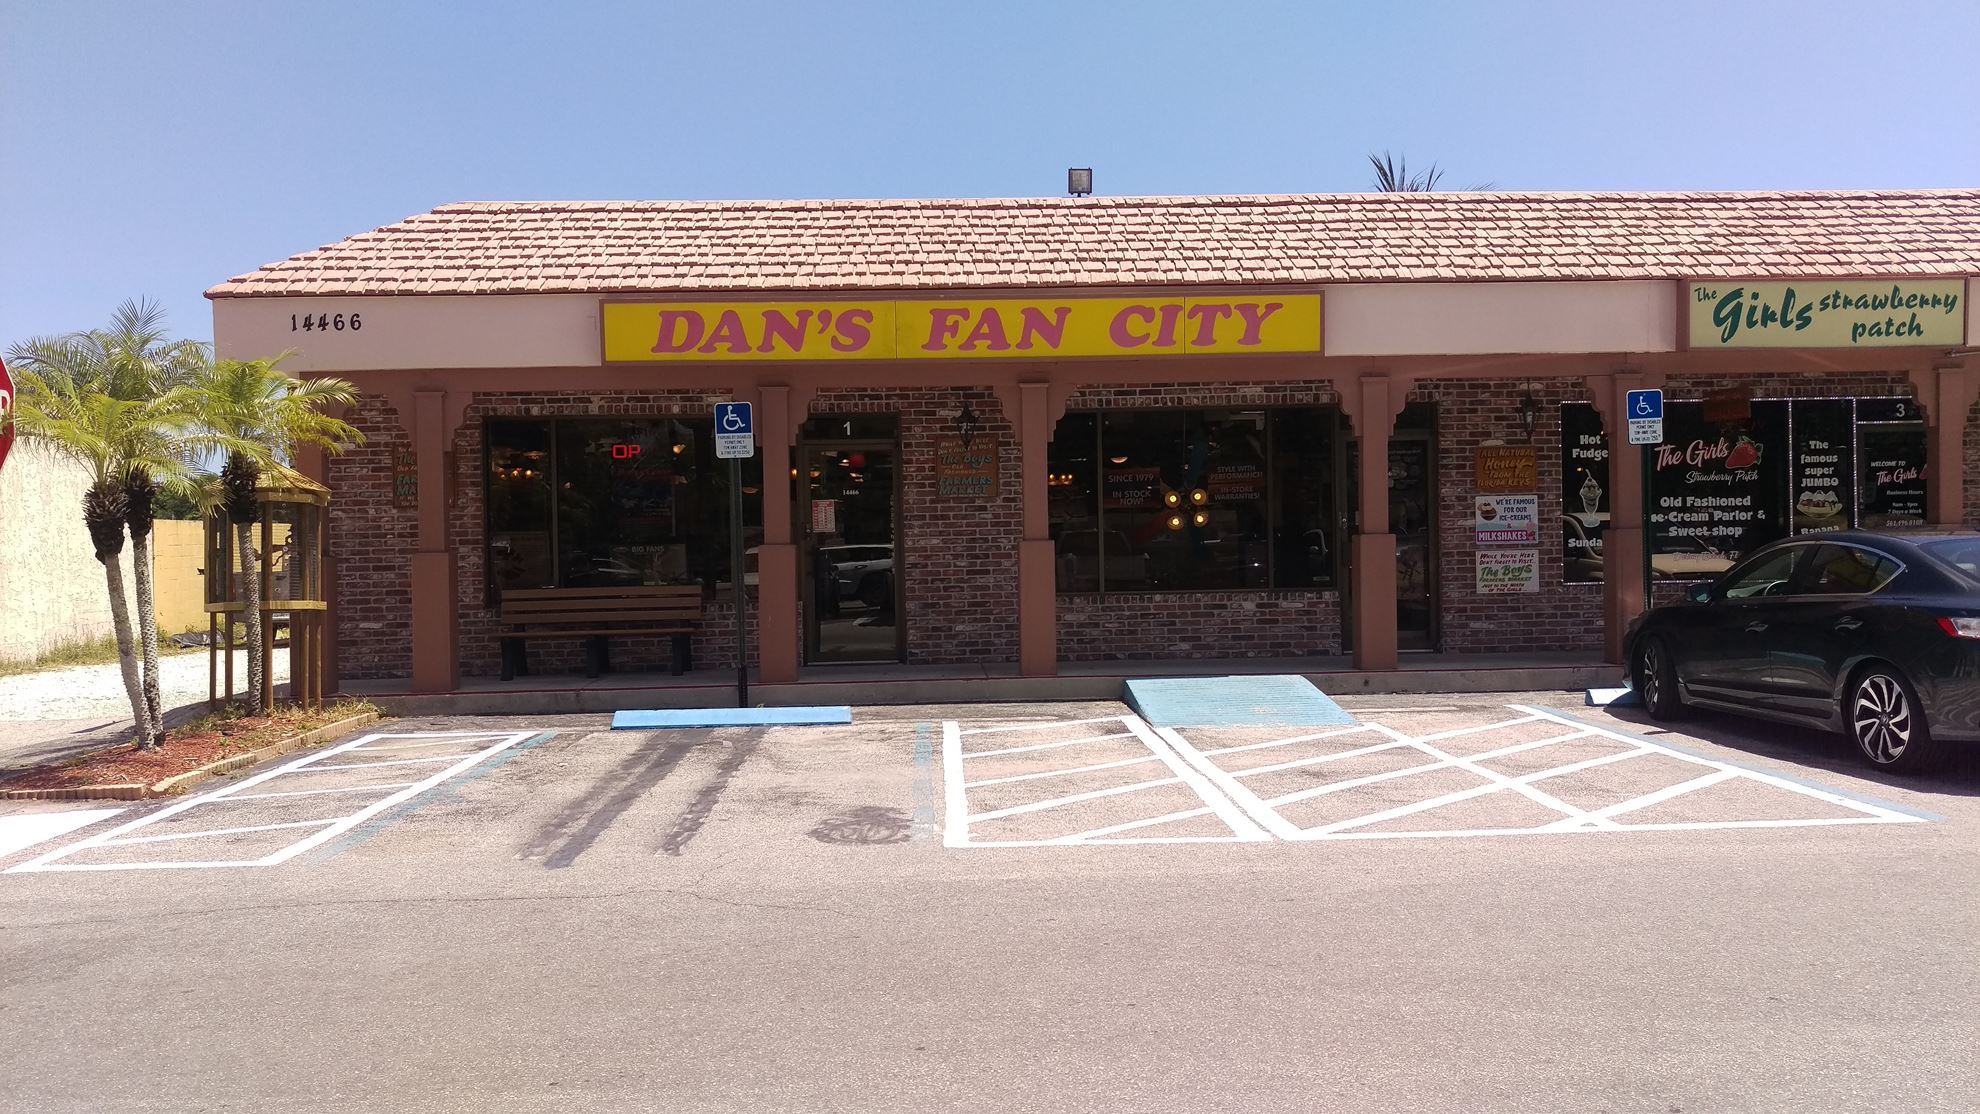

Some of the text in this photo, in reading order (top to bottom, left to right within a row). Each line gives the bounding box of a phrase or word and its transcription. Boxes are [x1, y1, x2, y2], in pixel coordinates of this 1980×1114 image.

[1819, 285, 1958, 314] strawberry
[1694, 287, 1813, 343] The Girls
[291, 313, 362, 332] 14466
[650, 301, 1284, 356] DAN'S FAN CITY
[1851, 313, 1924, 343] patch
[1895, 403, 1906, 418] 3
[843, 421, 851, 436] 1
[1580, 434, 1601, 445] Hot
[1809, 440, 1830, 449] The
[1572, 448, 1609, 461] Fudge
[1654, 437, 1730, 471] The Girls
[1800, 454, 1838, 464] famous
[1805, 466, 1834, 476] super
[1876, 466, 1918, 486] The Girls
[1108, 474, 1154, 483] SINCE 1979
[1684, 470, 1759, 486] Strawberry Patch
[1800, 477, 1839, 487] JUMBO
[1124, 490, 1151, 498] STOCK
[1660, 495, 1751, 507] Old Fashioned
[1650, 510, 1766, 522] ce-Cream Parlor &
[1478, 531, 1527, 541] MILKSHAKES
[1800, 525, 1840, 535] Banana
[1568, 537, 1603, 548] Sunda
[1481, 564, 1532, 577] The Boys
